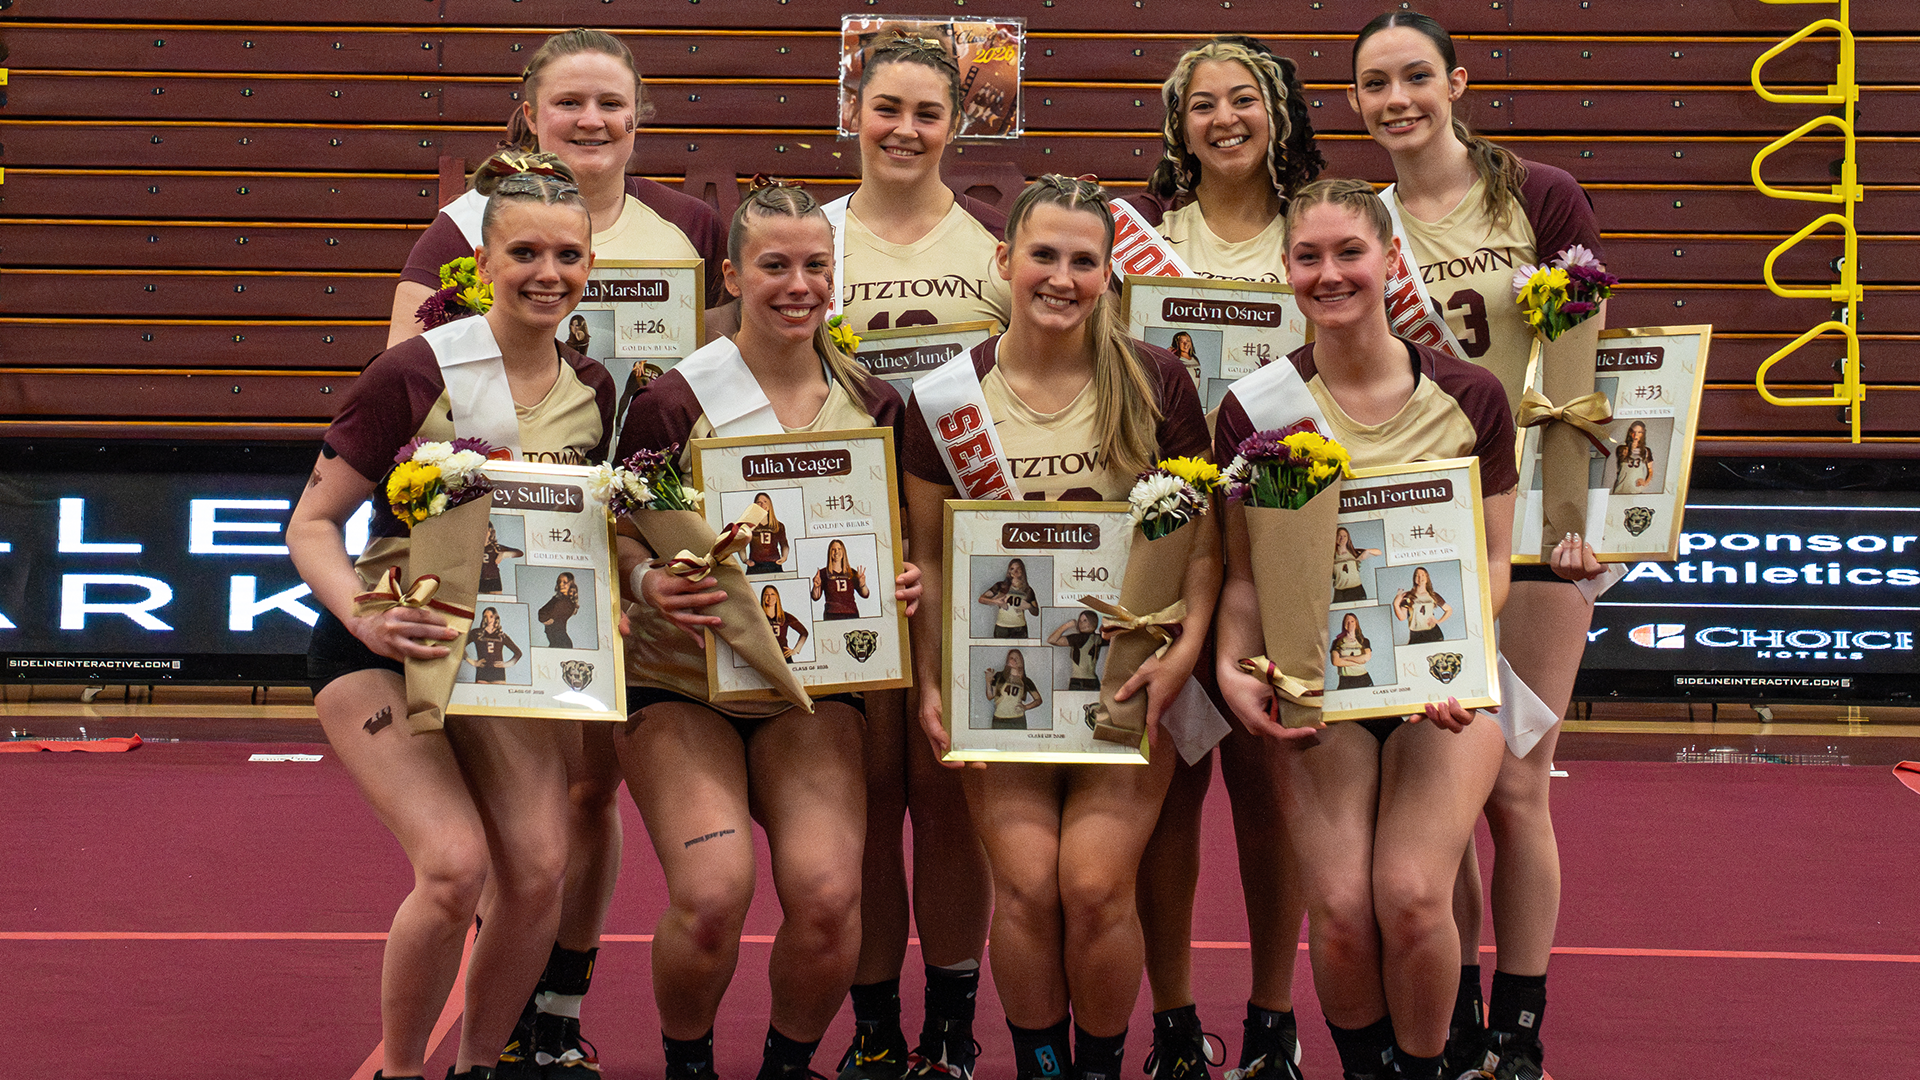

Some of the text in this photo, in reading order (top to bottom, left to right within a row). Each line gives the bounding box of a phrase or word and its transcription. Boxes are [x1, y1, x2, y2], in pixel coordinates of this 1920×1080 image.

[1420, 247, 1513, 285] ZTOWN
[601, 282, 663, 297] Marshall
[843, 275, 988, 307] UTZTOWN
[1167, 302, 1222, 321] Jordyn
[634, 318, 666, 334] #26
[1430, 288, 1491, 358] 3
[1242, 342, 1271, 358] #12
[856, 353, 913, 370] Sydney
[1597, 351, 1658, 367] tie Lewis
[1634, 384, 1663, 401] #33
[746, 456, 845, 477] Julia Yeager
[1627, 457, 1641, 468] 33
[493, 486, 577, 507] ey Sullick
[825, 494, 855, 512] #13
[1381, 486, 1447, 504] Fortuna
[0, 498, 373, 556] LE
[812, 522, 844, 531] GOLDEN
[1410, 523, 1436, 539] #4
[549, 527, 573, 543] #2
[760, 532, 772, 545] 13
[1009, 527, 1094, 543] Zoe Tuttle
[1679, 532, 1919, 555] ponsor
[1072, 566, 1109, 582] #40
[1622, 560, 1920, 586] Athletics
[835, 579, 848, 592] 13
[0, 573, 321, 632] RK
[1006, 595, 1021, 607] 40
[487, 642, 495, 653] 2
[1757, 650, 1865, 660] HOTELS
[9, 660, 170, 669] SIDELINEINTERACTIVE.COM
[1676, 677, 1840, 687] SIDELINEINTERACTIVE.COM
[1003, 684, 1019, 697] 40
